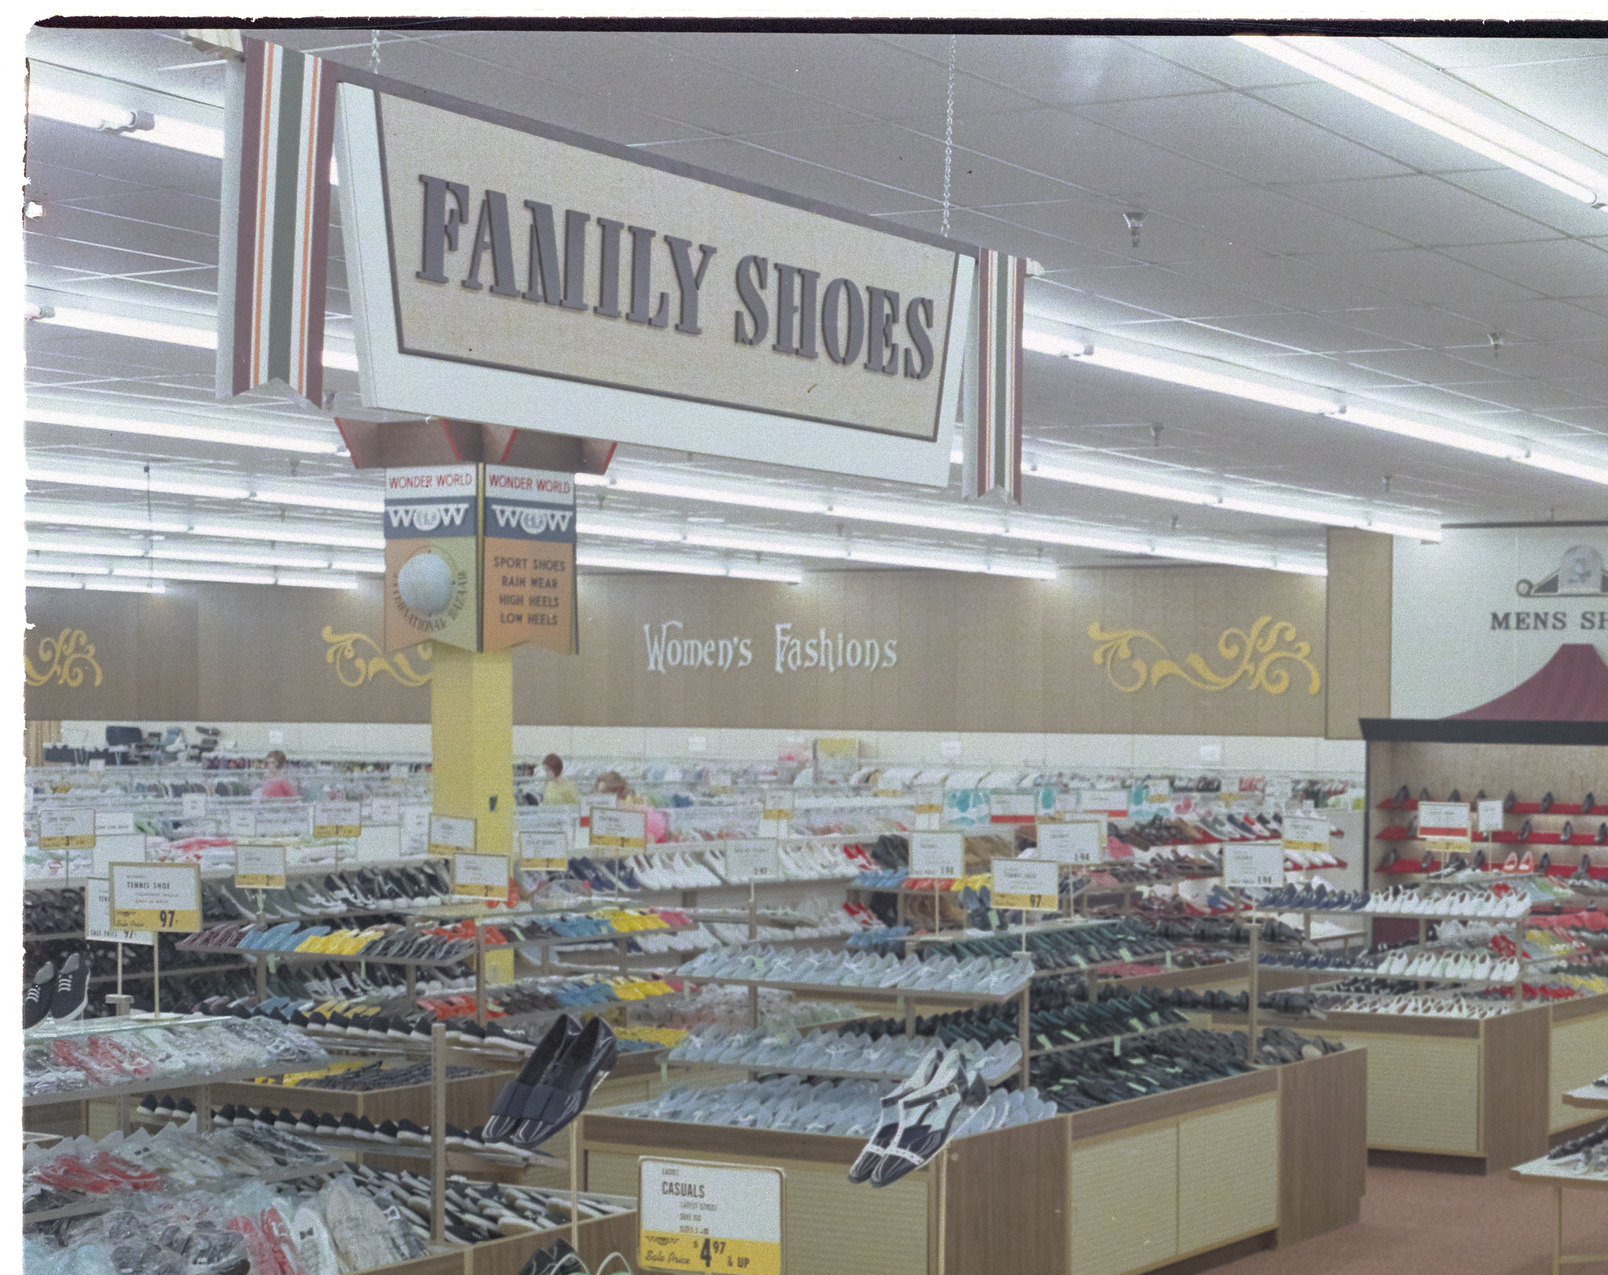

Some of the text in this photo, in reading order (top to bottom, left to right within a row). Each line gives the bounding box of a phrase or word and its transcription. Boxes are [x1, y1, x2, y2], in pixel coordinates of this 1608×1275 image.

[416, 174, 936, 381] FAMILY SHOES
[389, 473, 472, 489] WONDER WORLD
[489, 475, 570, 494] WONDER WORLD
[494, 556, 565, 572] SPORT SHOES
[502, 576, 558, 588] RAIN WEAR
[499, 594, 559, 607] HIGH HEELS
[500, 613, 558, 625] LOW HEELS
[1490, 611, 1567, 631] MENS
[643, 621, 898, 672] Women's Fashions
[662, 1181, 705, 1198] CASUALS
[738, 1257, 750, 1268] UP
